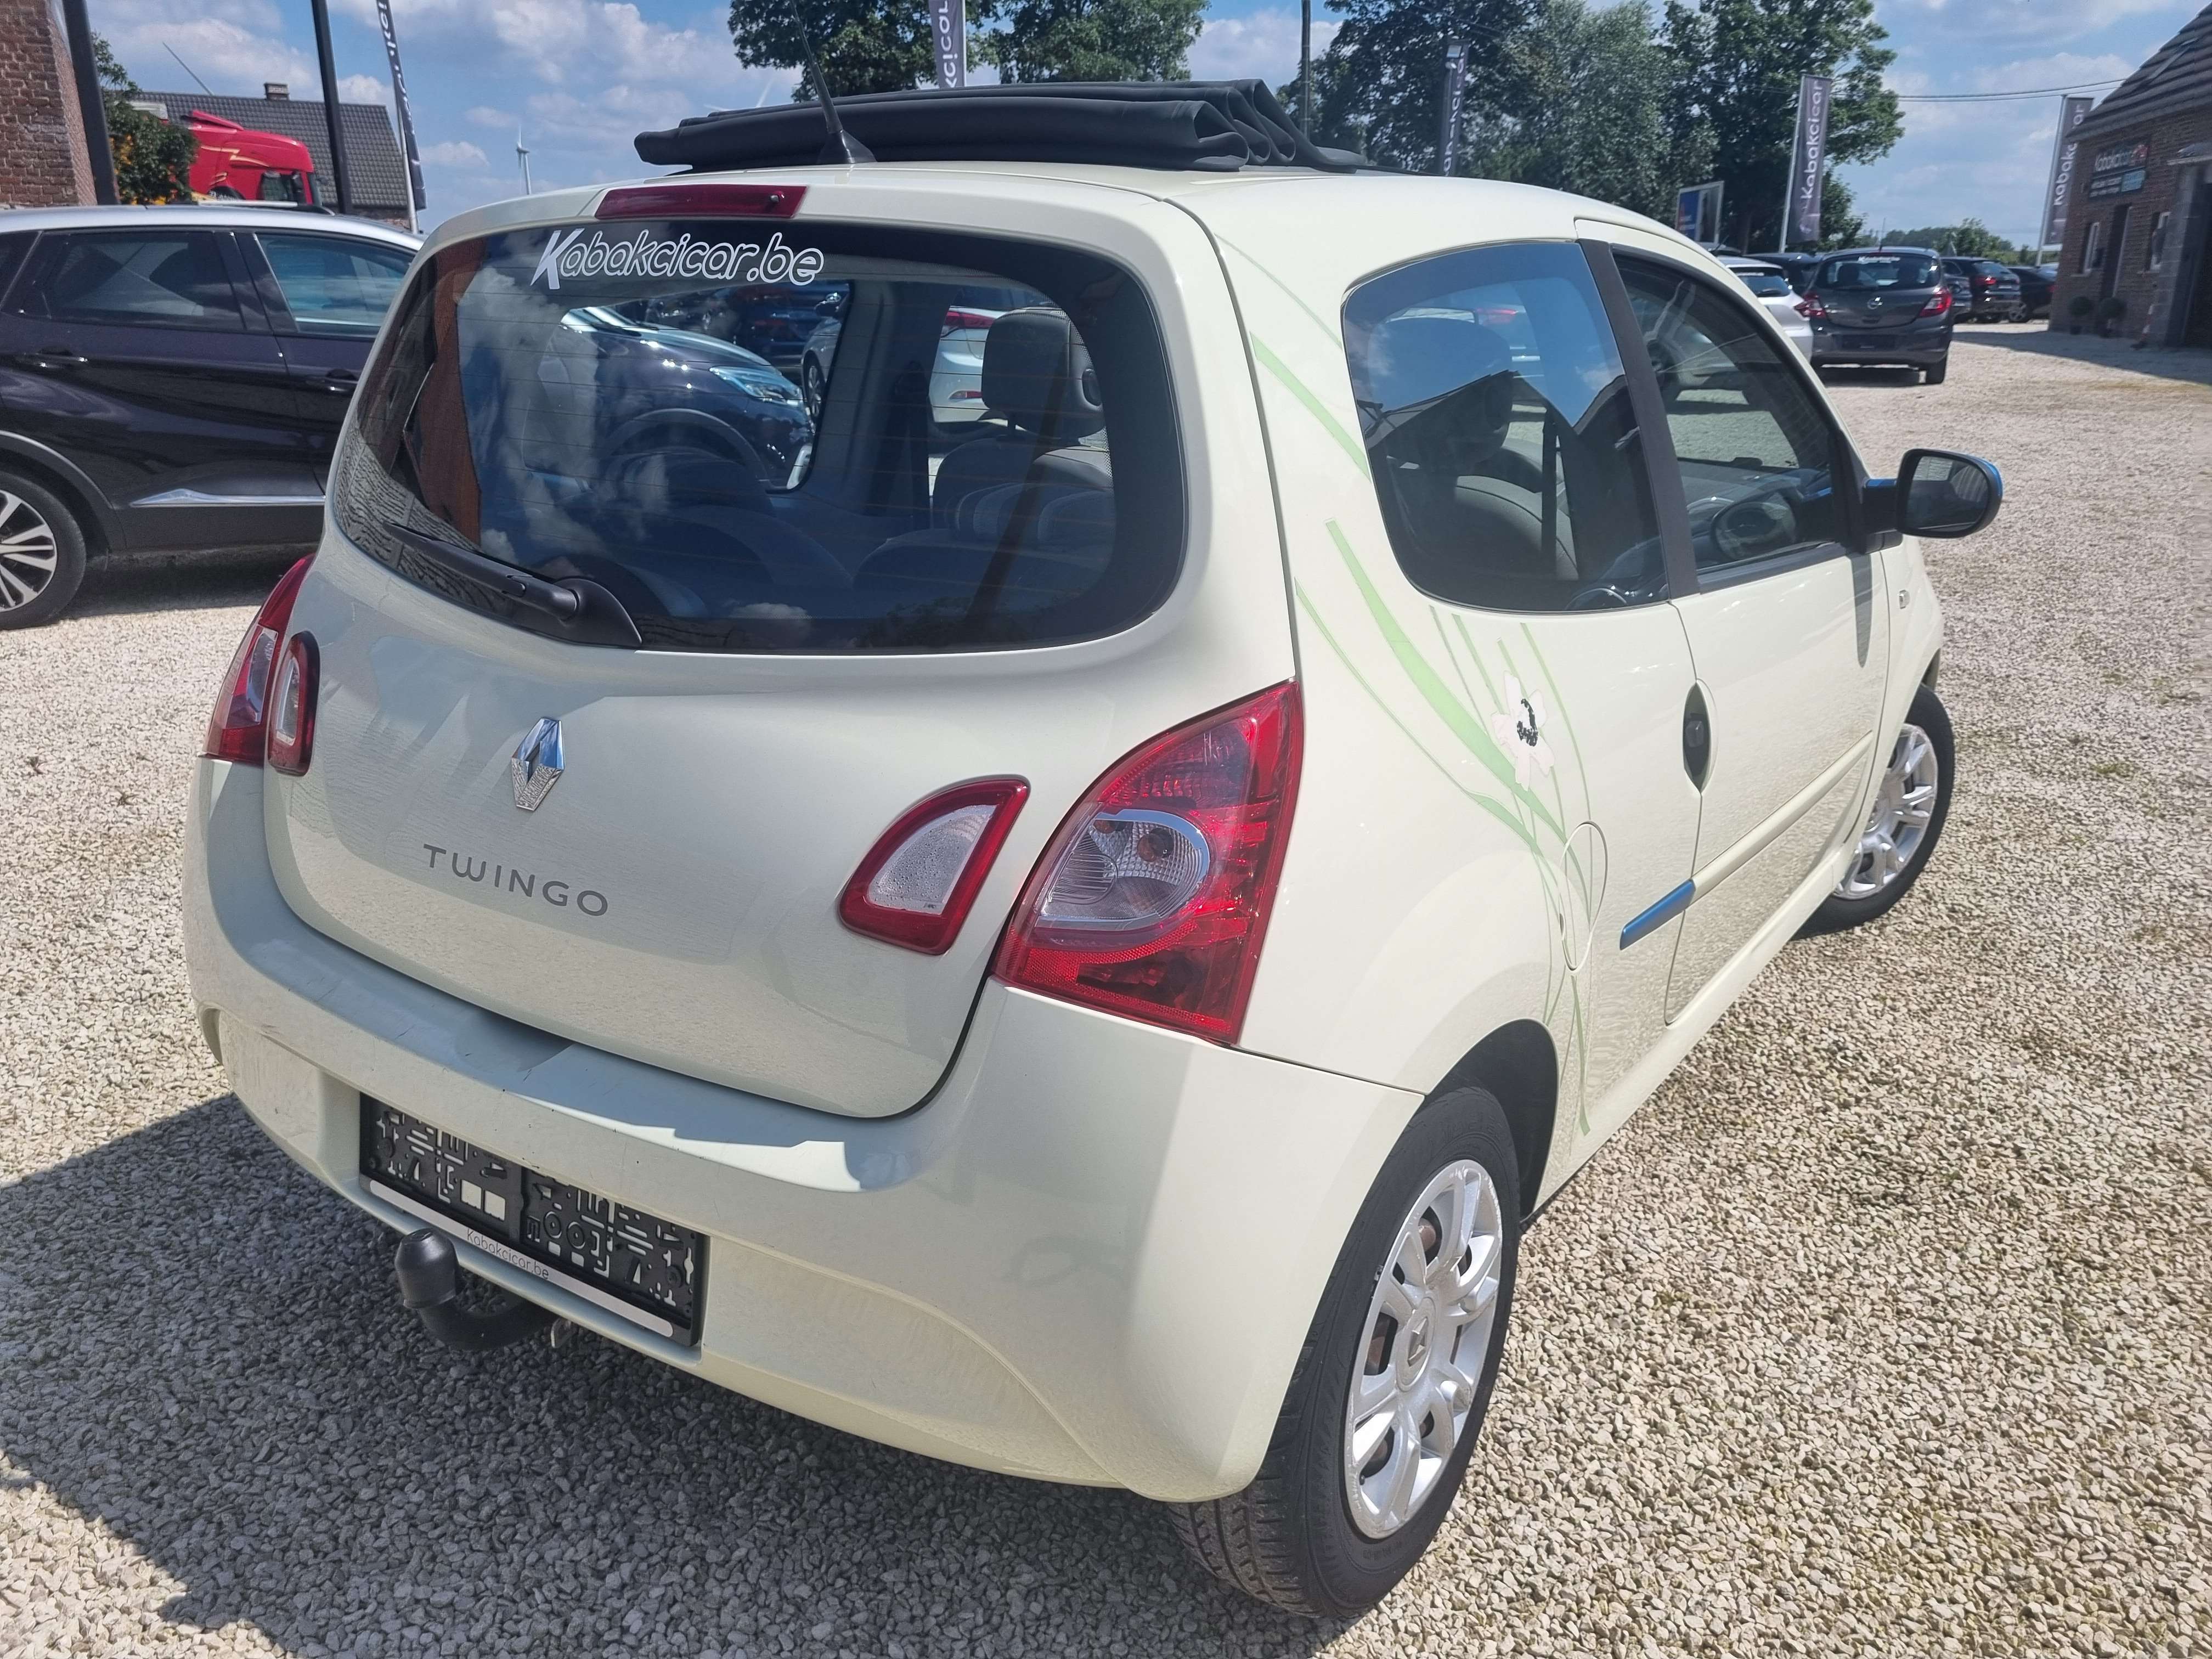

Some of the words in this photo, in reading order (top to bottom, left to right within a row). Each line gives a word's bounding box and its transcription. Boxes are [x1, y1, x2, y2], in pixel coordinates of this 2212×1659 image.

[1801, 80, 1822, 199] Kabakcicar
[2053, 105, 2085, 206] Kabakcar
[530, 228, 824, 290] Kabakcicar.be
[423, 843, 608, 917] TWINGO
[466, 1228, 549, 1279] Kabakcicar.be
